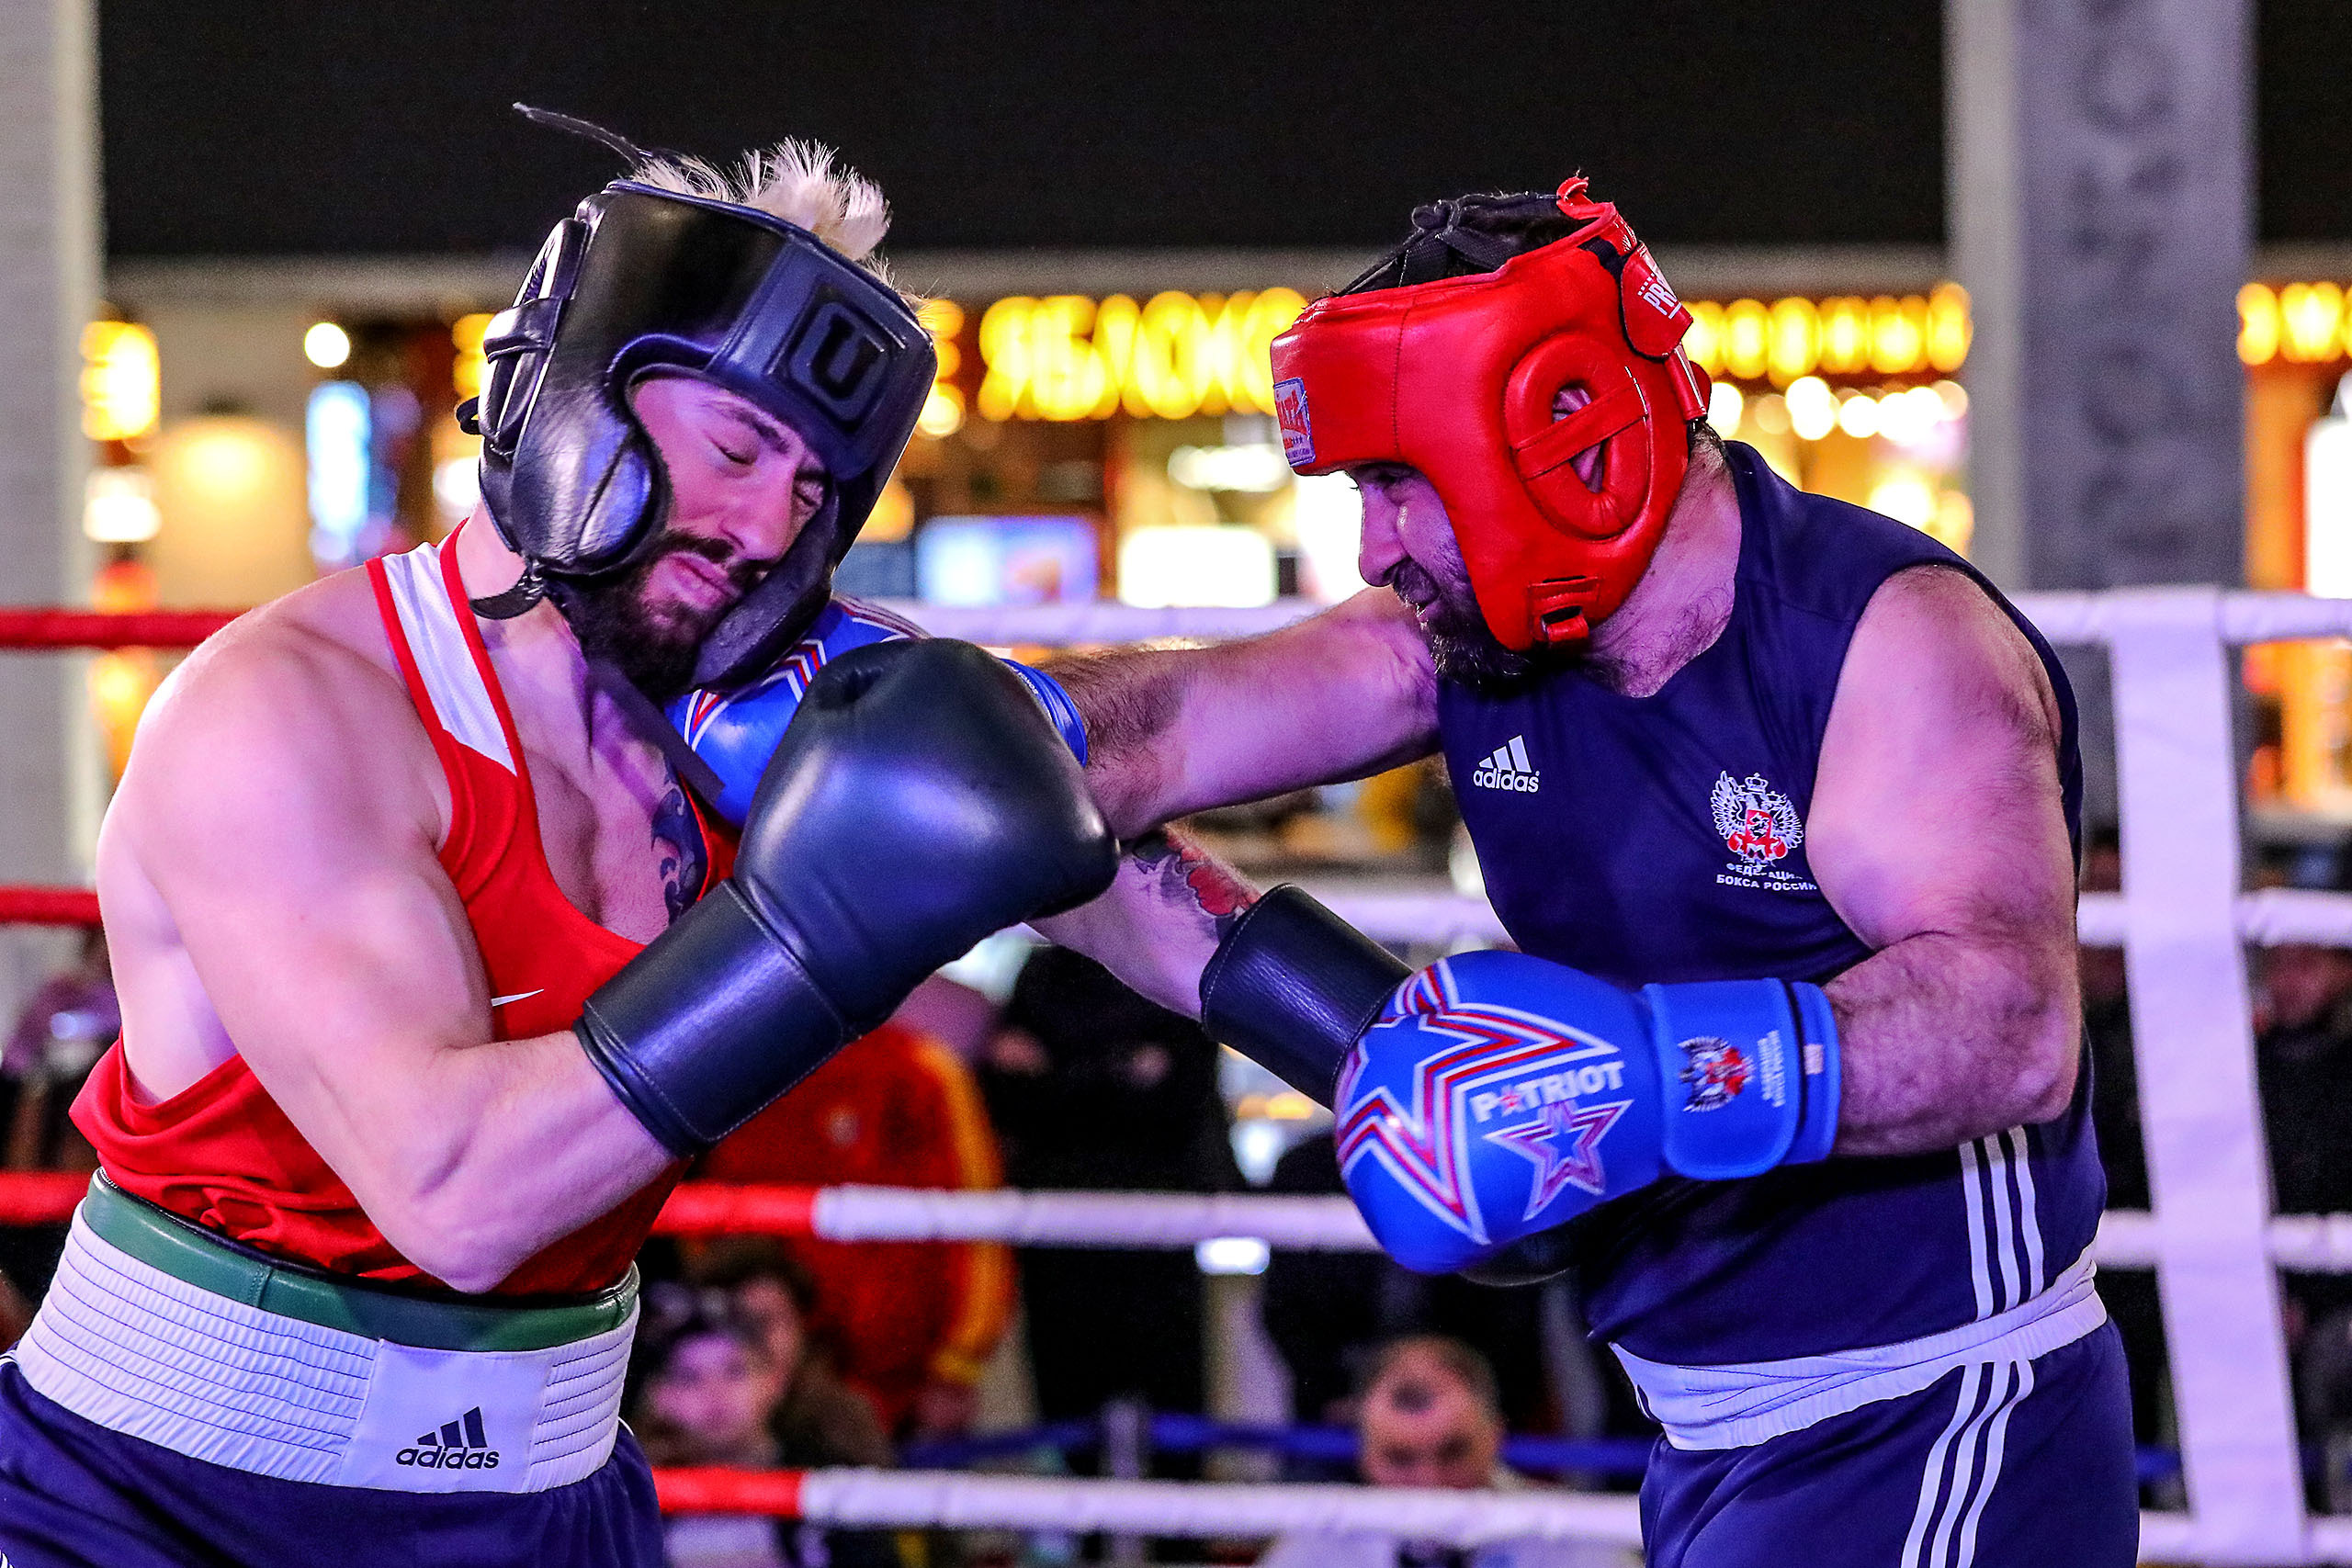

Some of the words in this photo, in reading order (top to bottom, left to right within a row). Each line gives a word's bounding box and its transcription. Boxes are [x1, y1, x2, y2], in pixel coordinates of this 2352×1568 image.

[1473, 768, 1539, 793] adidas
[1716, 874, 1760, 889] БОКСА
[396, 1445, 500, 1469] adidas
